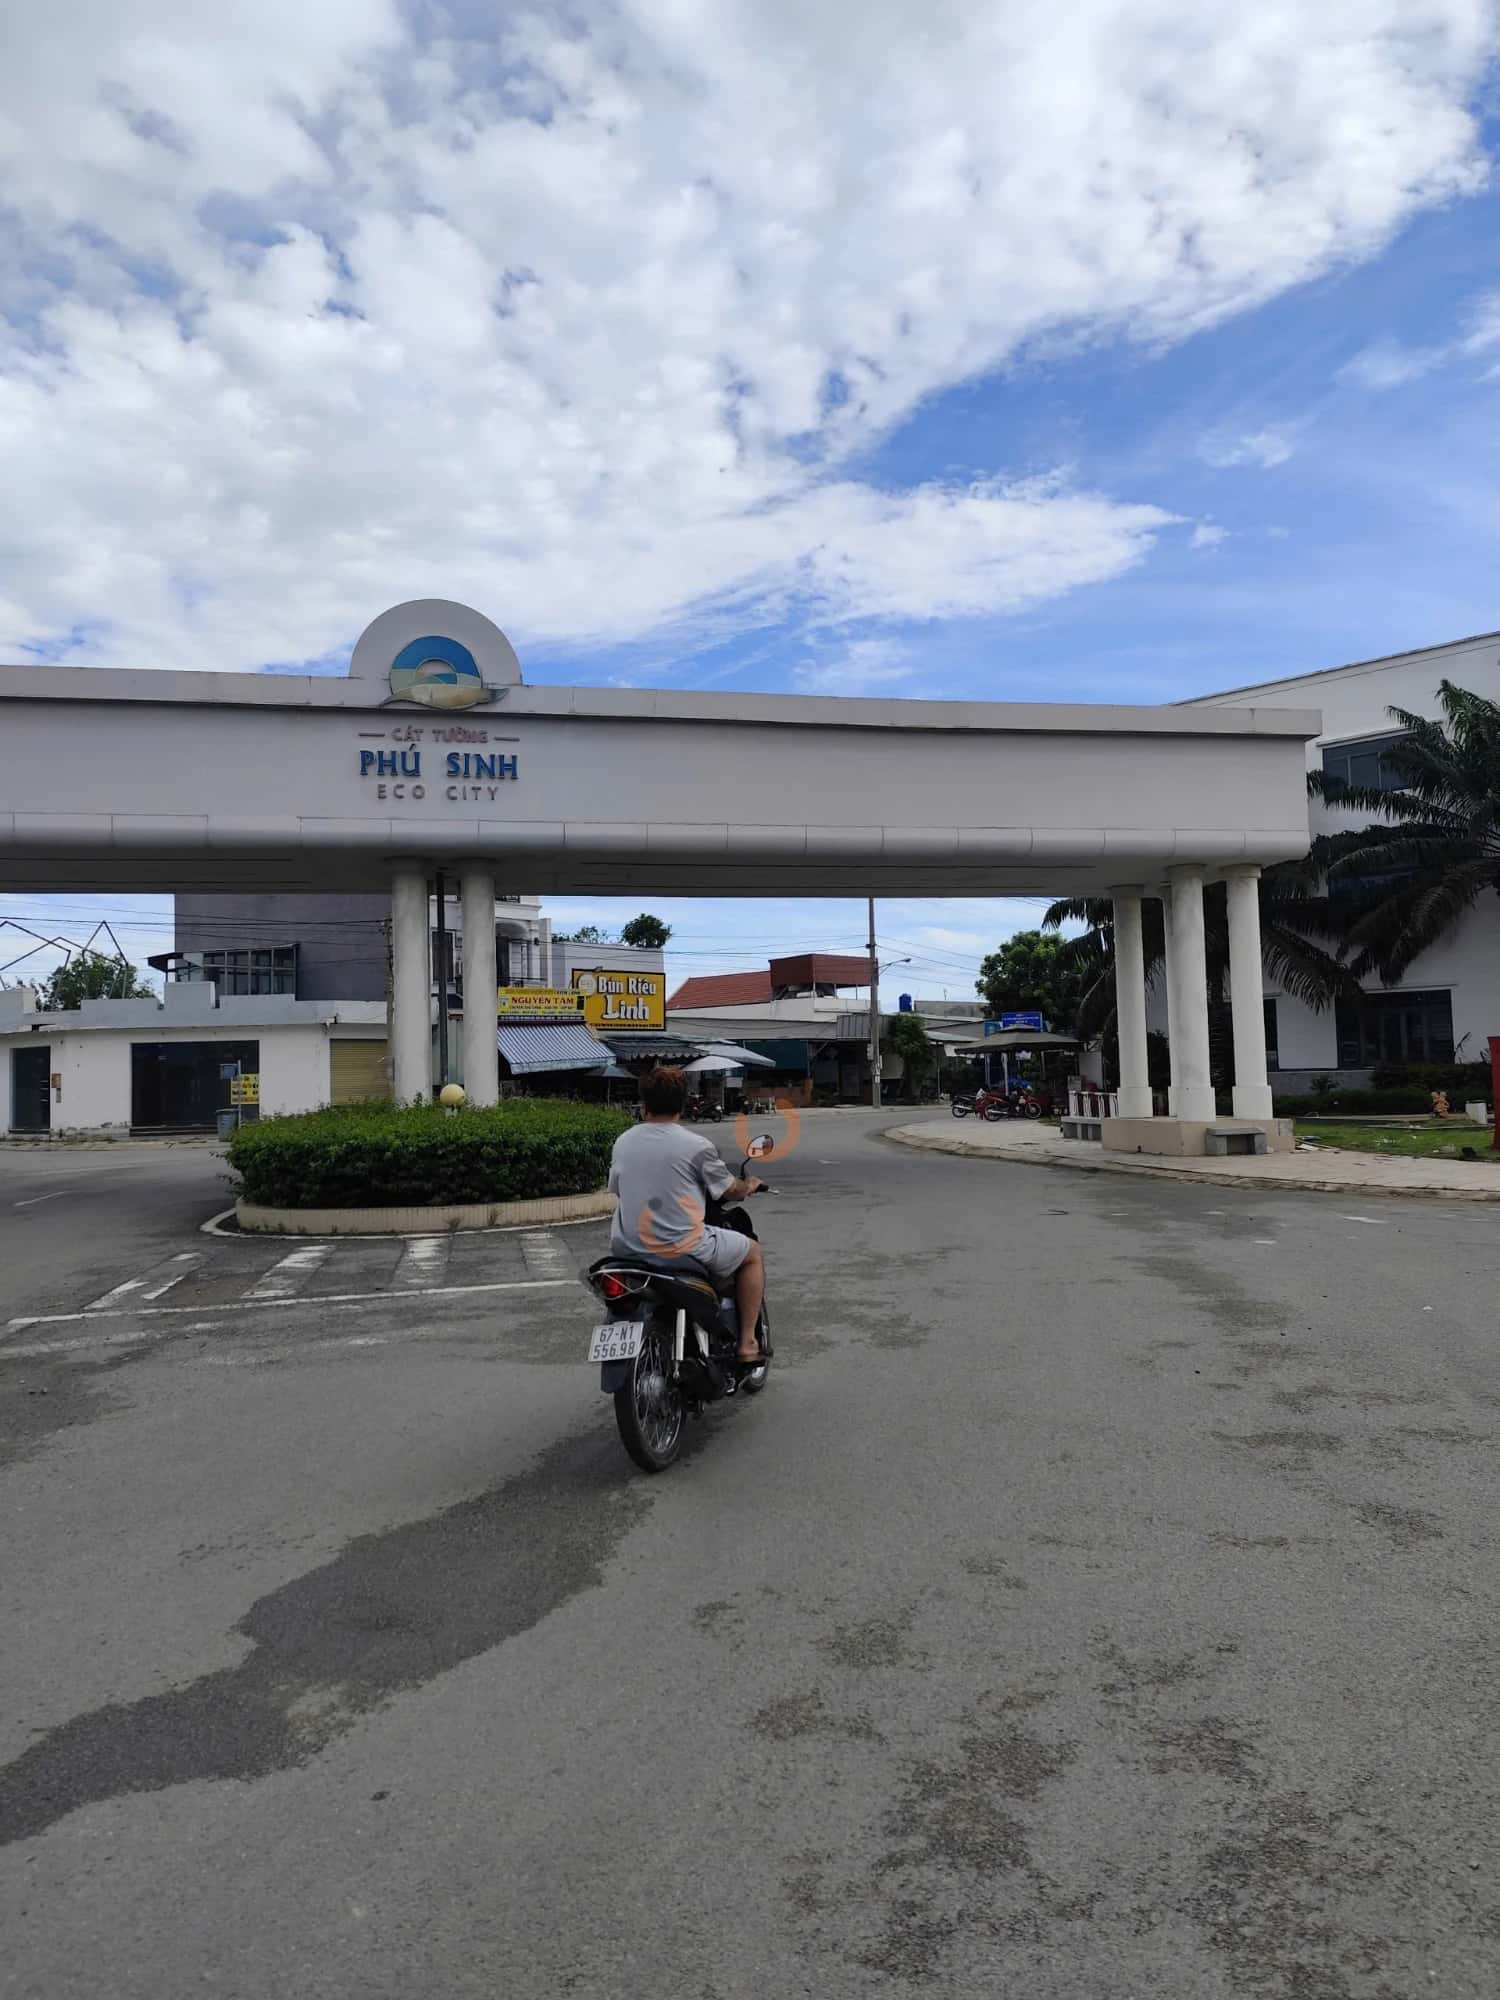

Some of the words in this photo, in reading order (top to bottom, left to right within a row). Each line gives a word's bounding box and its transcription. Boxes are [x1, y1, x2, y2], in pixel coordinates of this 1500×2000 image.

[359, 743, 422, 777] PHÚ
[446, 752, 519, 780] SINH
[377, 784, 426, 800] ECO
[446, 786, 499, 801] CITY
[602, 994, 650, 1020] Linh
